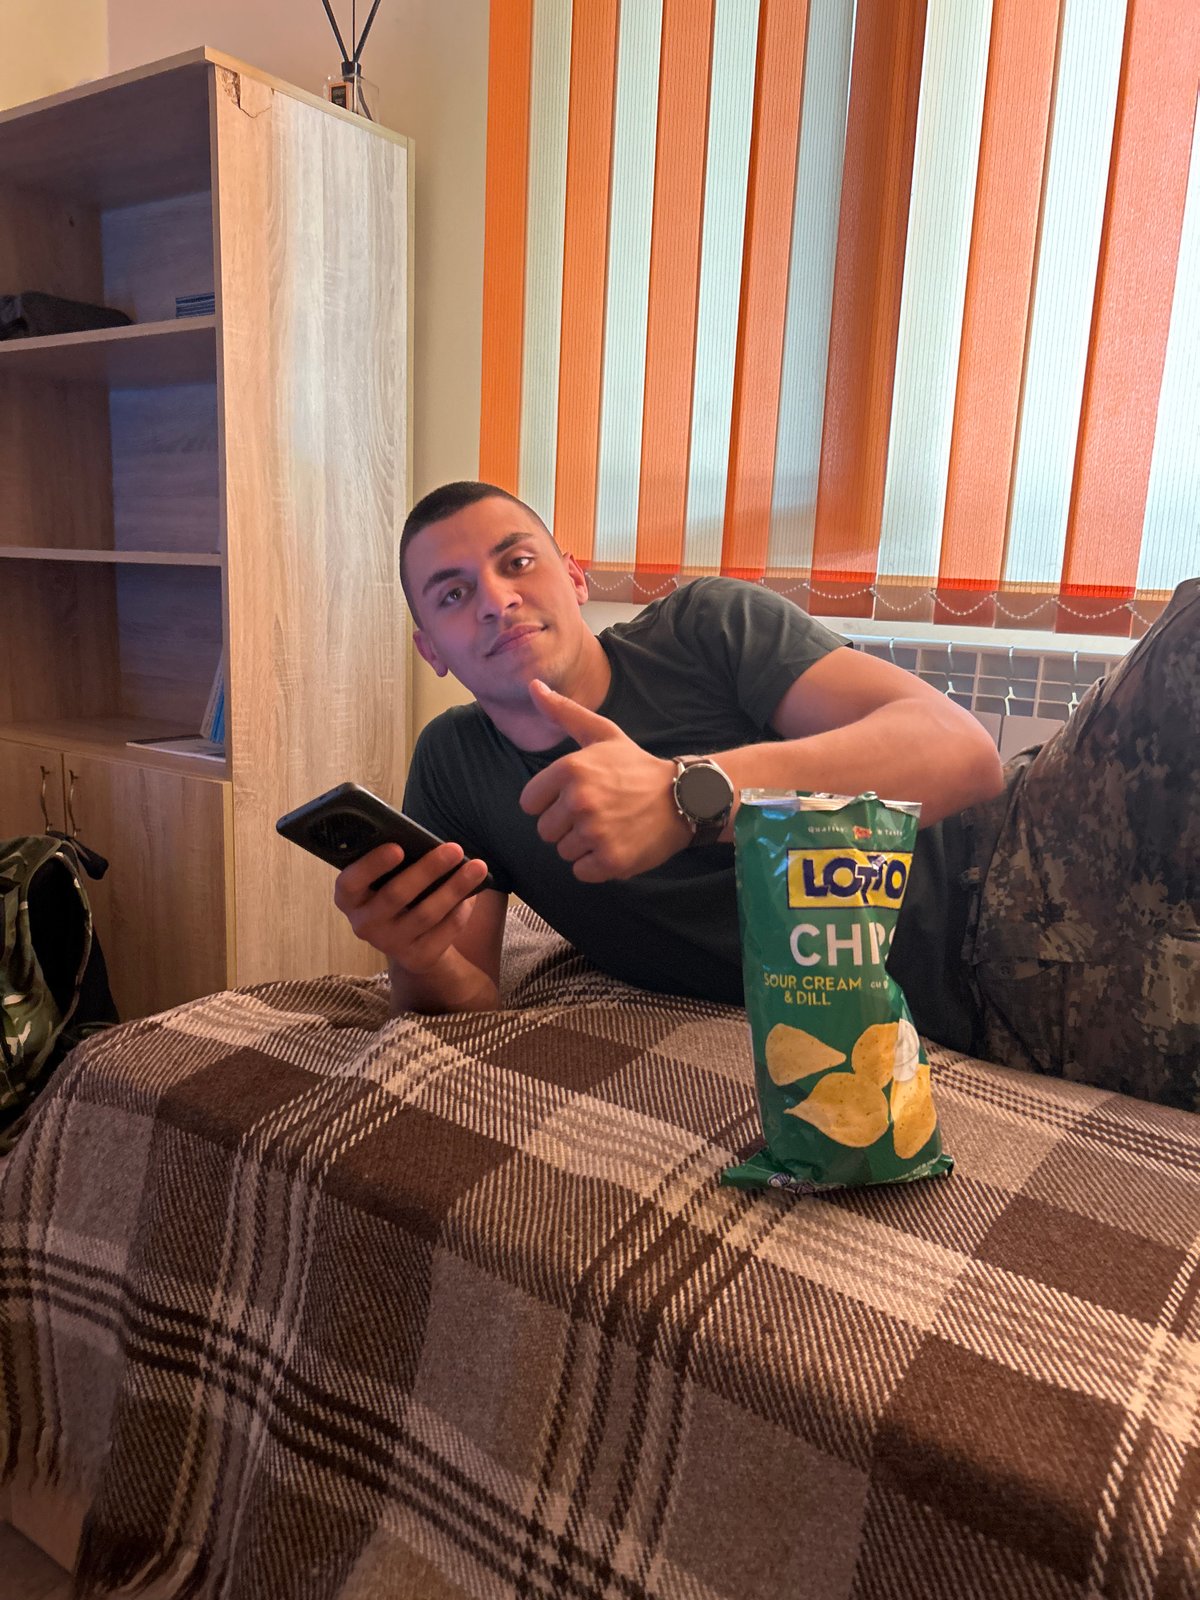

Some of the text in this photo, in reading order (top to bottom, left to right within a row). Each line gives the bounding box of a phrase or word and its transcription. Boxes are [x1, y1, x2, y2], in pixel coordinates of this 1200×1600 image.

[789, 921, 897, 967] CHIP
[763, 972, 862, 991] SOUR CREAM
[784, 990, 831, 1006] & DILL
